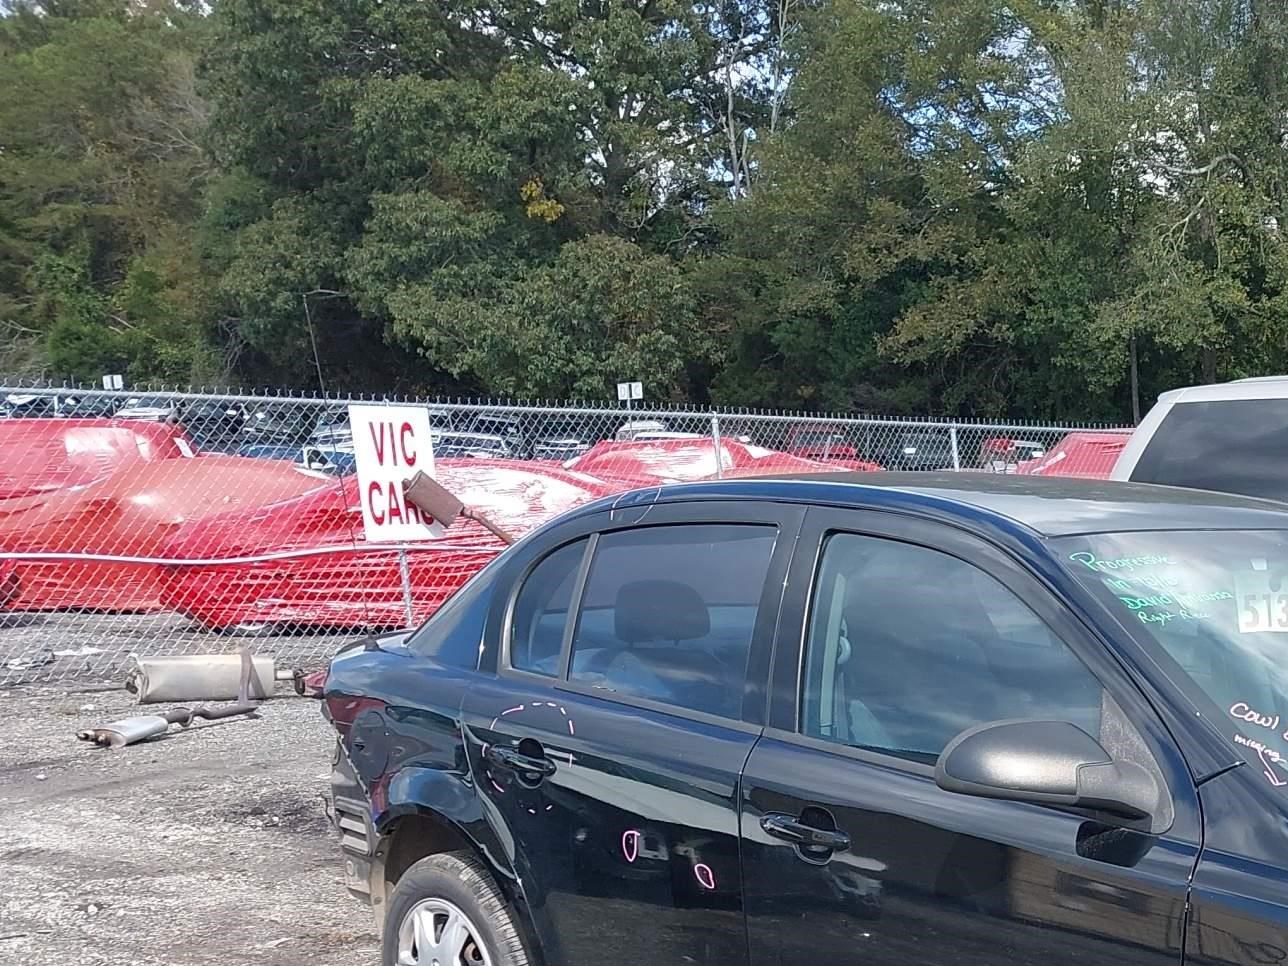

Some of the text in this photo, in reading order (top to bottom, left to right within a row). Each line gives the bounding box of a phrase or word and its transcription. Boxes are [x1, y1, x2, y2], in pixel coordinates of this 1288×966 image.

[368, 421, 417, 467] VIC
[368, 478, 435, 526] CAR
[1230, 702, 1280, 730] Cowl
